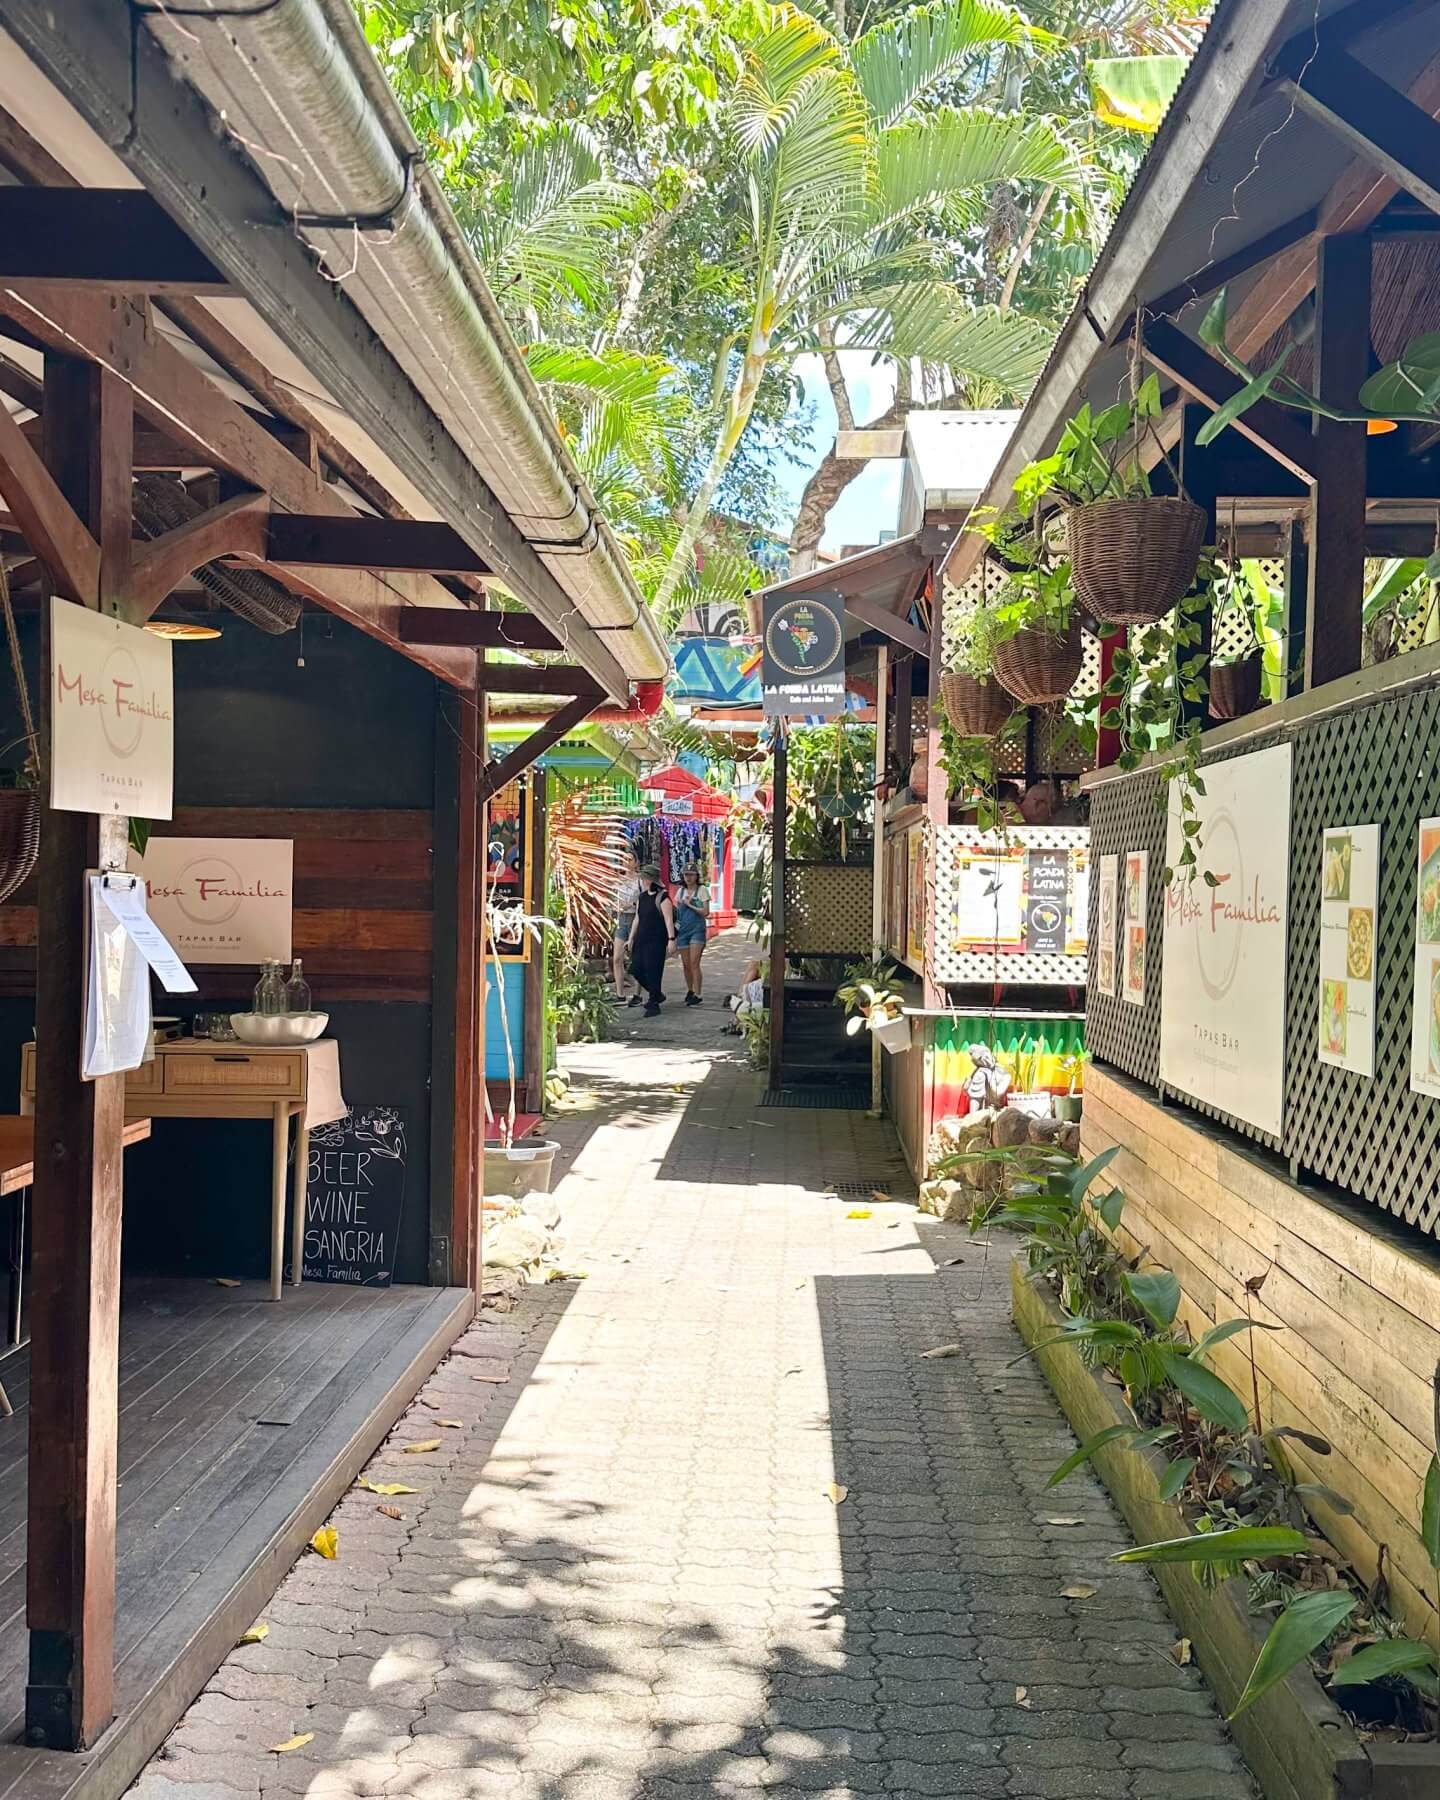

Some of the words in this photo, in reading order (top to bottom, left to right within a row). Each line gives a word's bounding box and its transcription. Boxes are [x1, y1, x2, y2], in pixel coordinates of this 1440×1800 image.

[57, 663, 108, 706] Mesa
[112, 678, 172, 721] Familia
[764, 684, 778, 695] LA
[1042, 855, 1056, 865] LA
[1032, 867, 1065, 877] FONDA
[195, 878, 288, 901] Familia
[1032, 879, 1065, 889] LATINA
[1166, 886, 1203, 928] Mesa
[1210, 873, 1281, 933] Familia
[219, 934, 242, 942] BAR
[1193, 1023, 1219, 1046] TAPAS
[1221, 1031, 1240, 1052] BAR
[307, 1150, 375, 1186] BEER
[307, 1191, 370, 1225] WINE
[304, 1230, 385, 1265] SANGRIA
[326, 1264, 362, 1281] Familia
